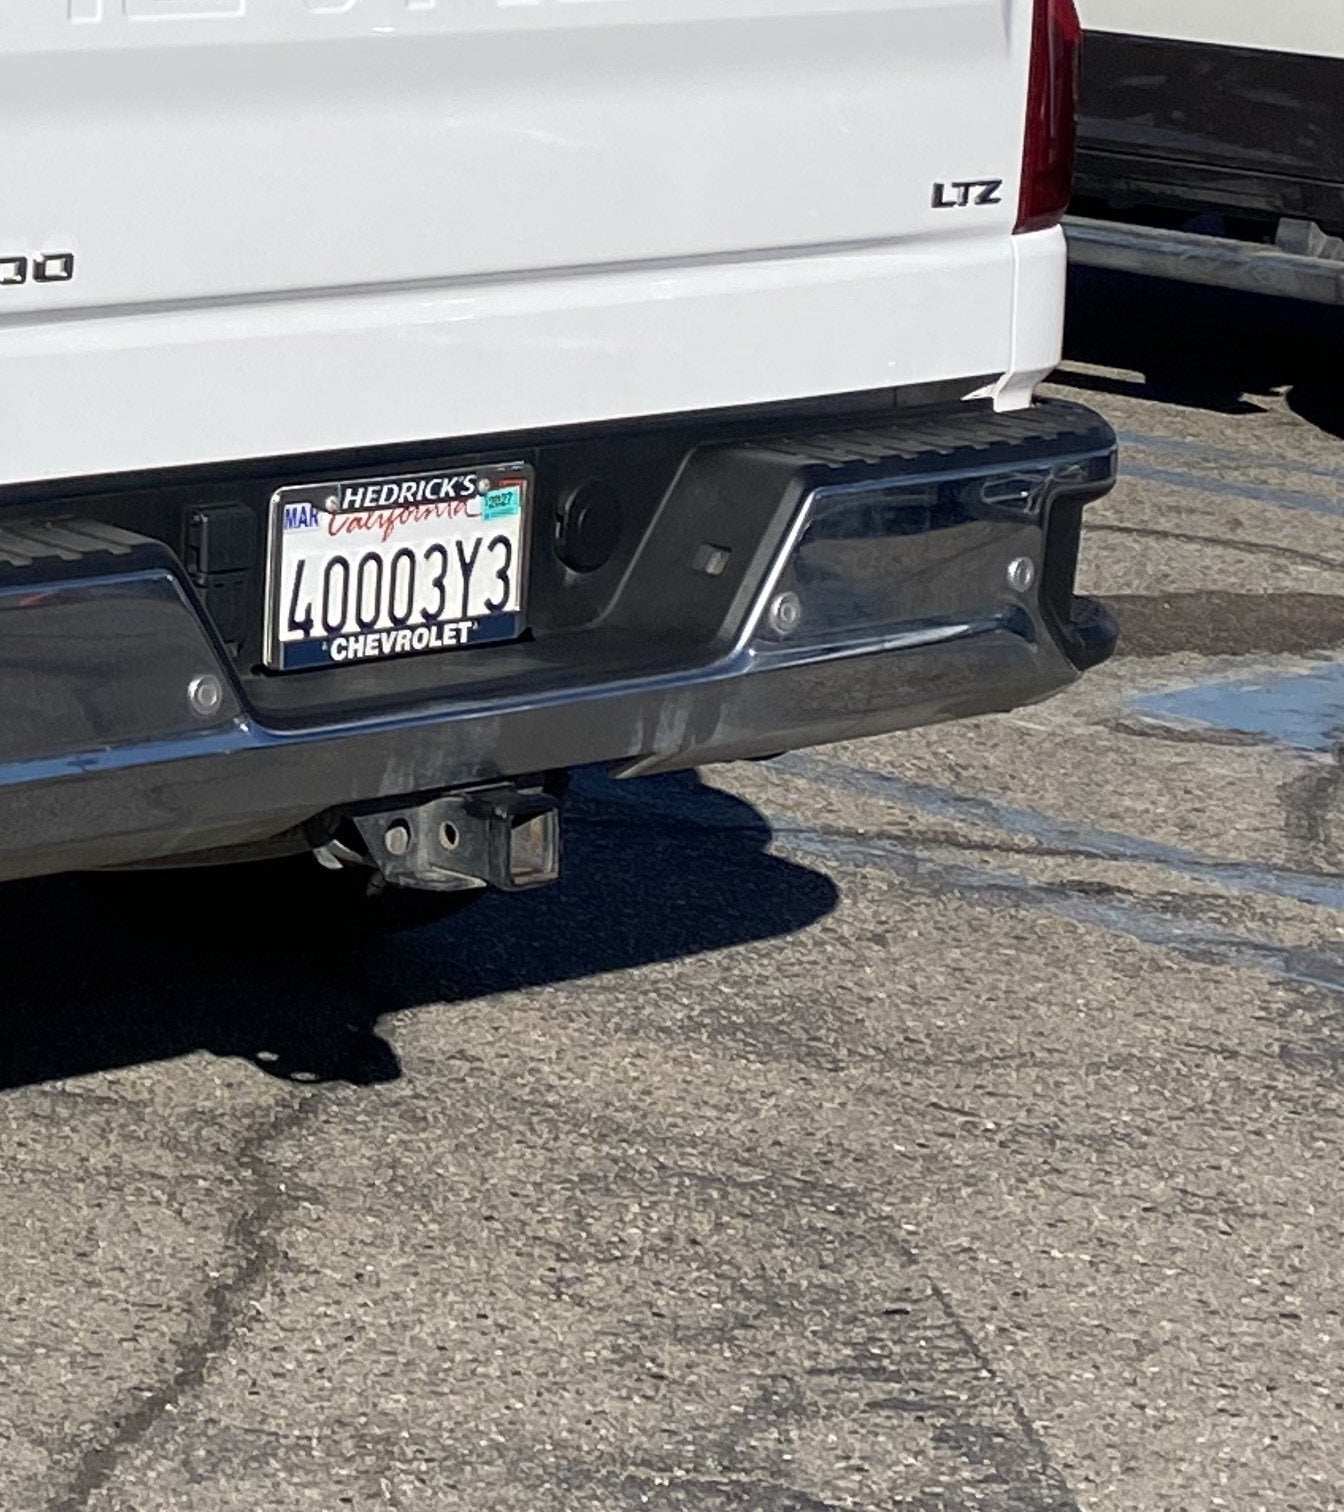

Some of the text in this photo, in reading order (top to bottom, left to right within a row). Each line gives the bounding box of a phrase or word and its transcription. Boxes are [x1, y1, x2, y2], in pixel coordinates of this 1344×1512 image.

[930, 179, 1003, 209] LTZ
[341, 474, 477, 510] HEDRICK'S
[284, 504, 319, 529] MAR
[288, 534, 513, 639] 40003Y3
[329, 620, 474, 663] CHEVROLET
